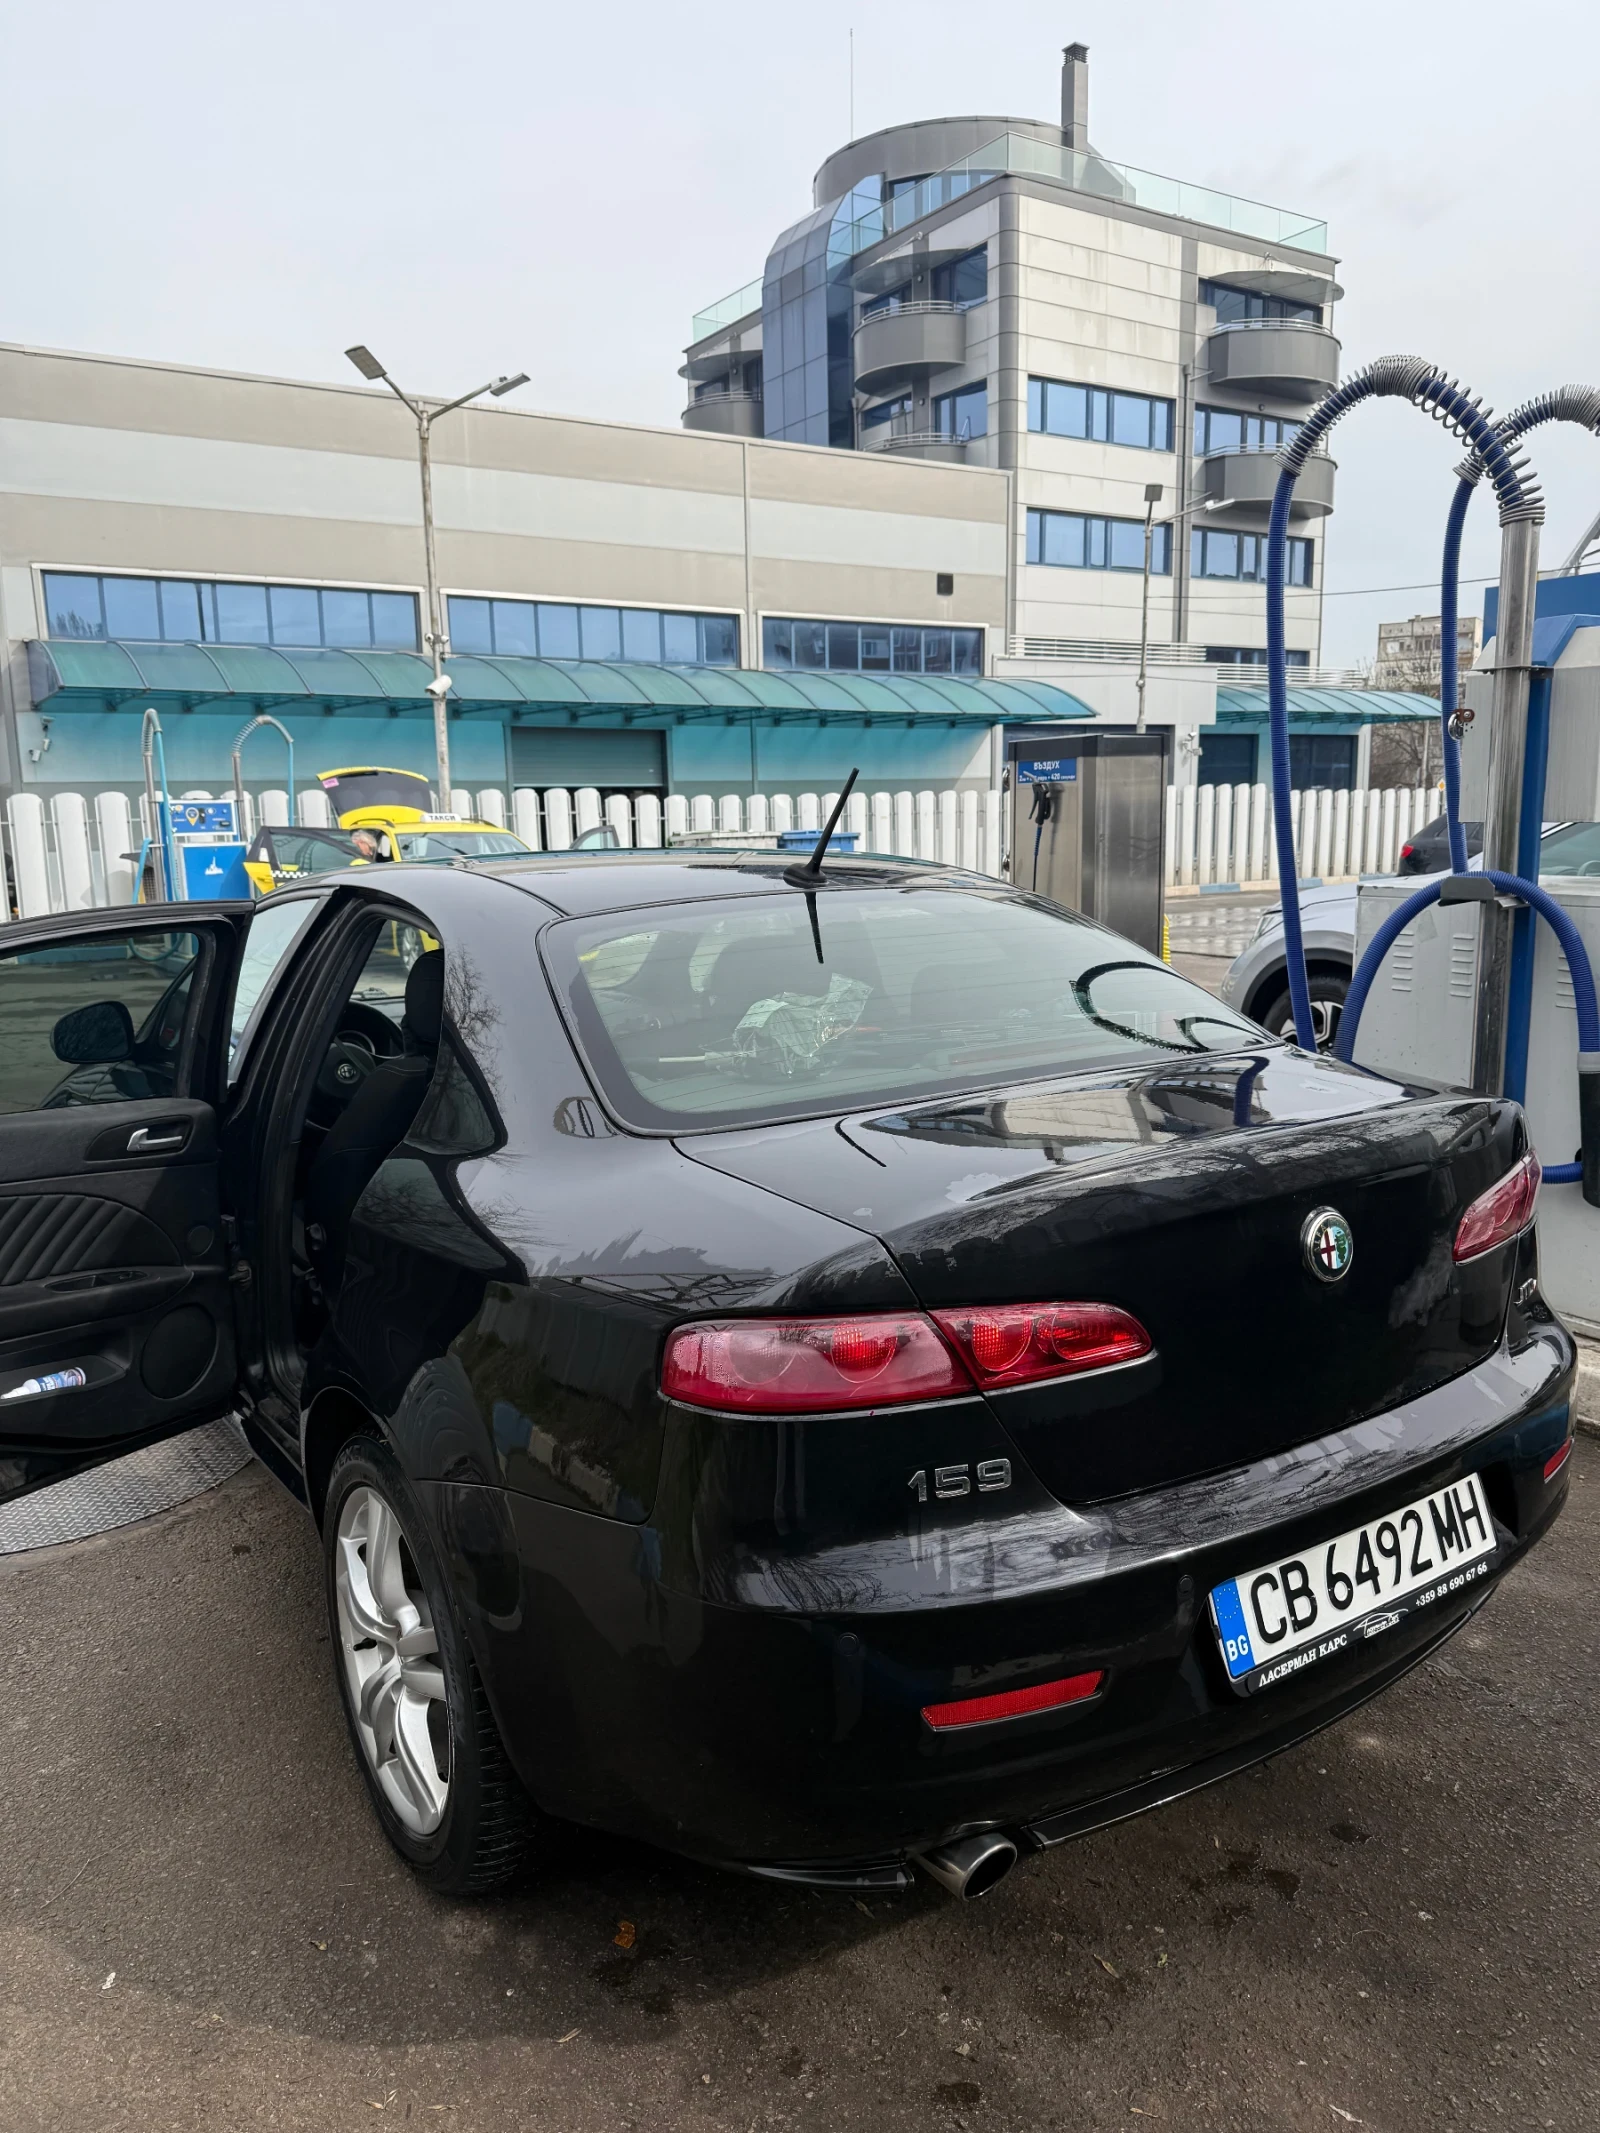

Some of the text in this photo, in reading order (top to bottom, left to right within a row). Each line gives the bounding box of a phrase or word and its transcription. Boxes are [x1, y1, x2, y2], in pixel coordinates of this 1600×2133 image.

[1033, 760, 1060, 770] ВЪЗДУХ
[907, 1458, 1012, 1502] 159
[1415, 1561, 1488, 1607] +359 88 690 67 66
[1226, 1634, 1249, 1662] BG
[1318, 1634, 1348, 1658] КАРС
